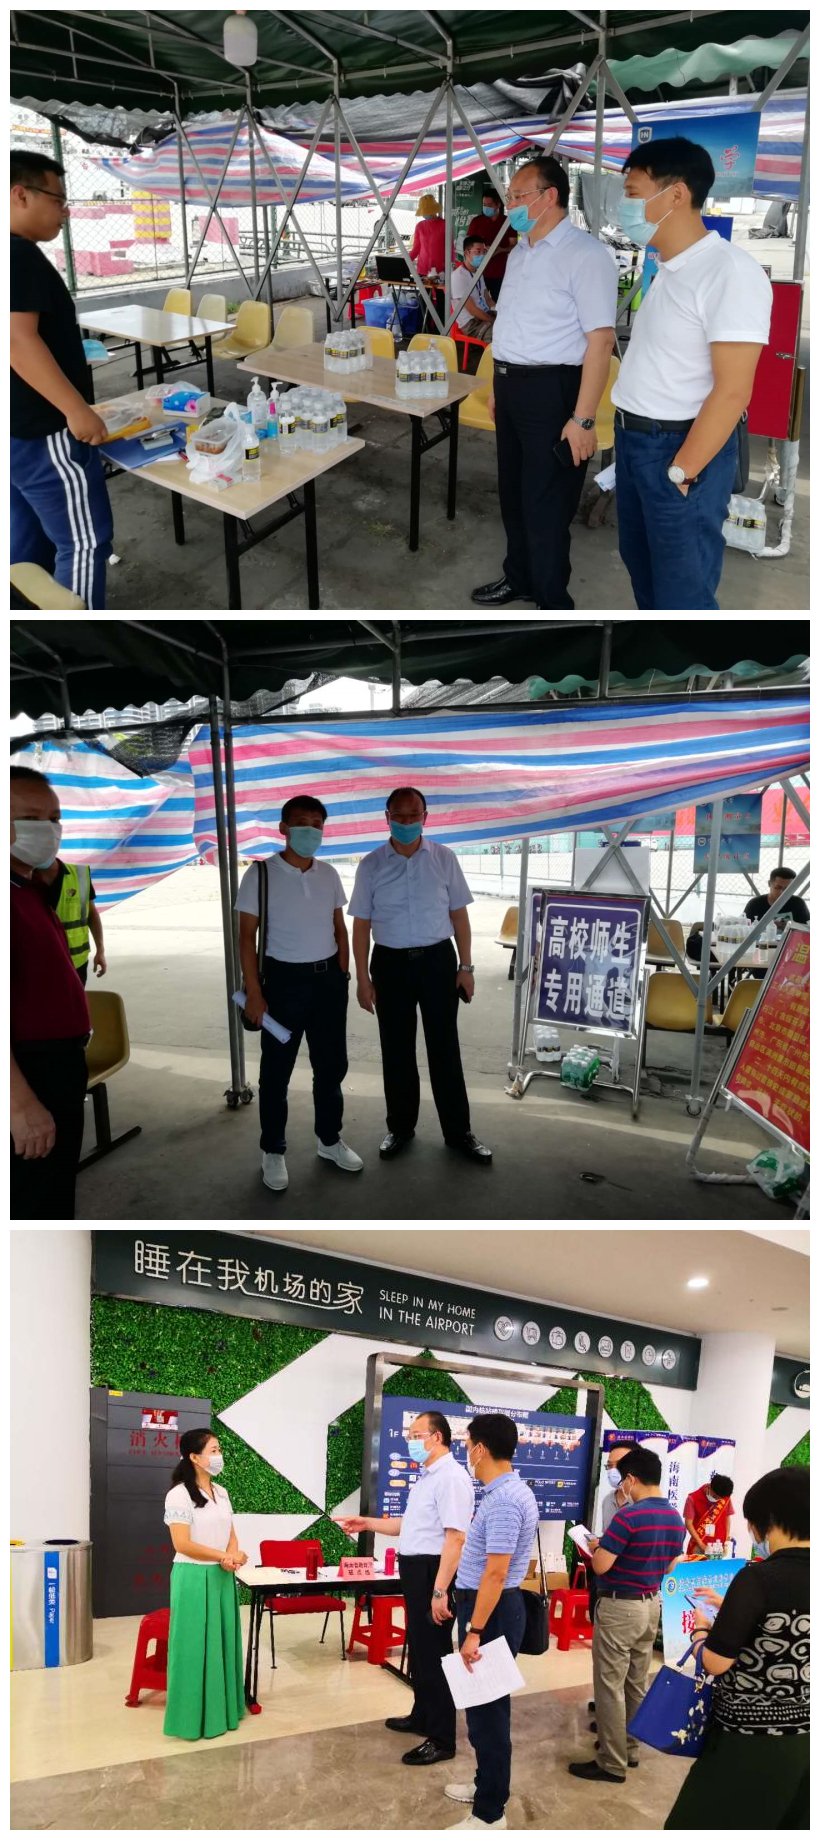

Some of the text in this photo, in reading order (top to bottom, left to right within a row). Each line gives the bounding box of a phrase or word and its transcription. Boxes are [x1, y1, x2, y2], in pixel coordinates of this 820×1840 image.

[548, 915, 632, 964] 高校师生
[543, 967, 632, 1021] 专用通道
[134, 1239, 364, 1315] 睡在我机场的家
[379, 1289, 476, 1319] SLEEP IN MY HOME
[379, 1306, 475, 1336] IN THE AIRPORT
[388, 1428, 399, 1438] 1F
